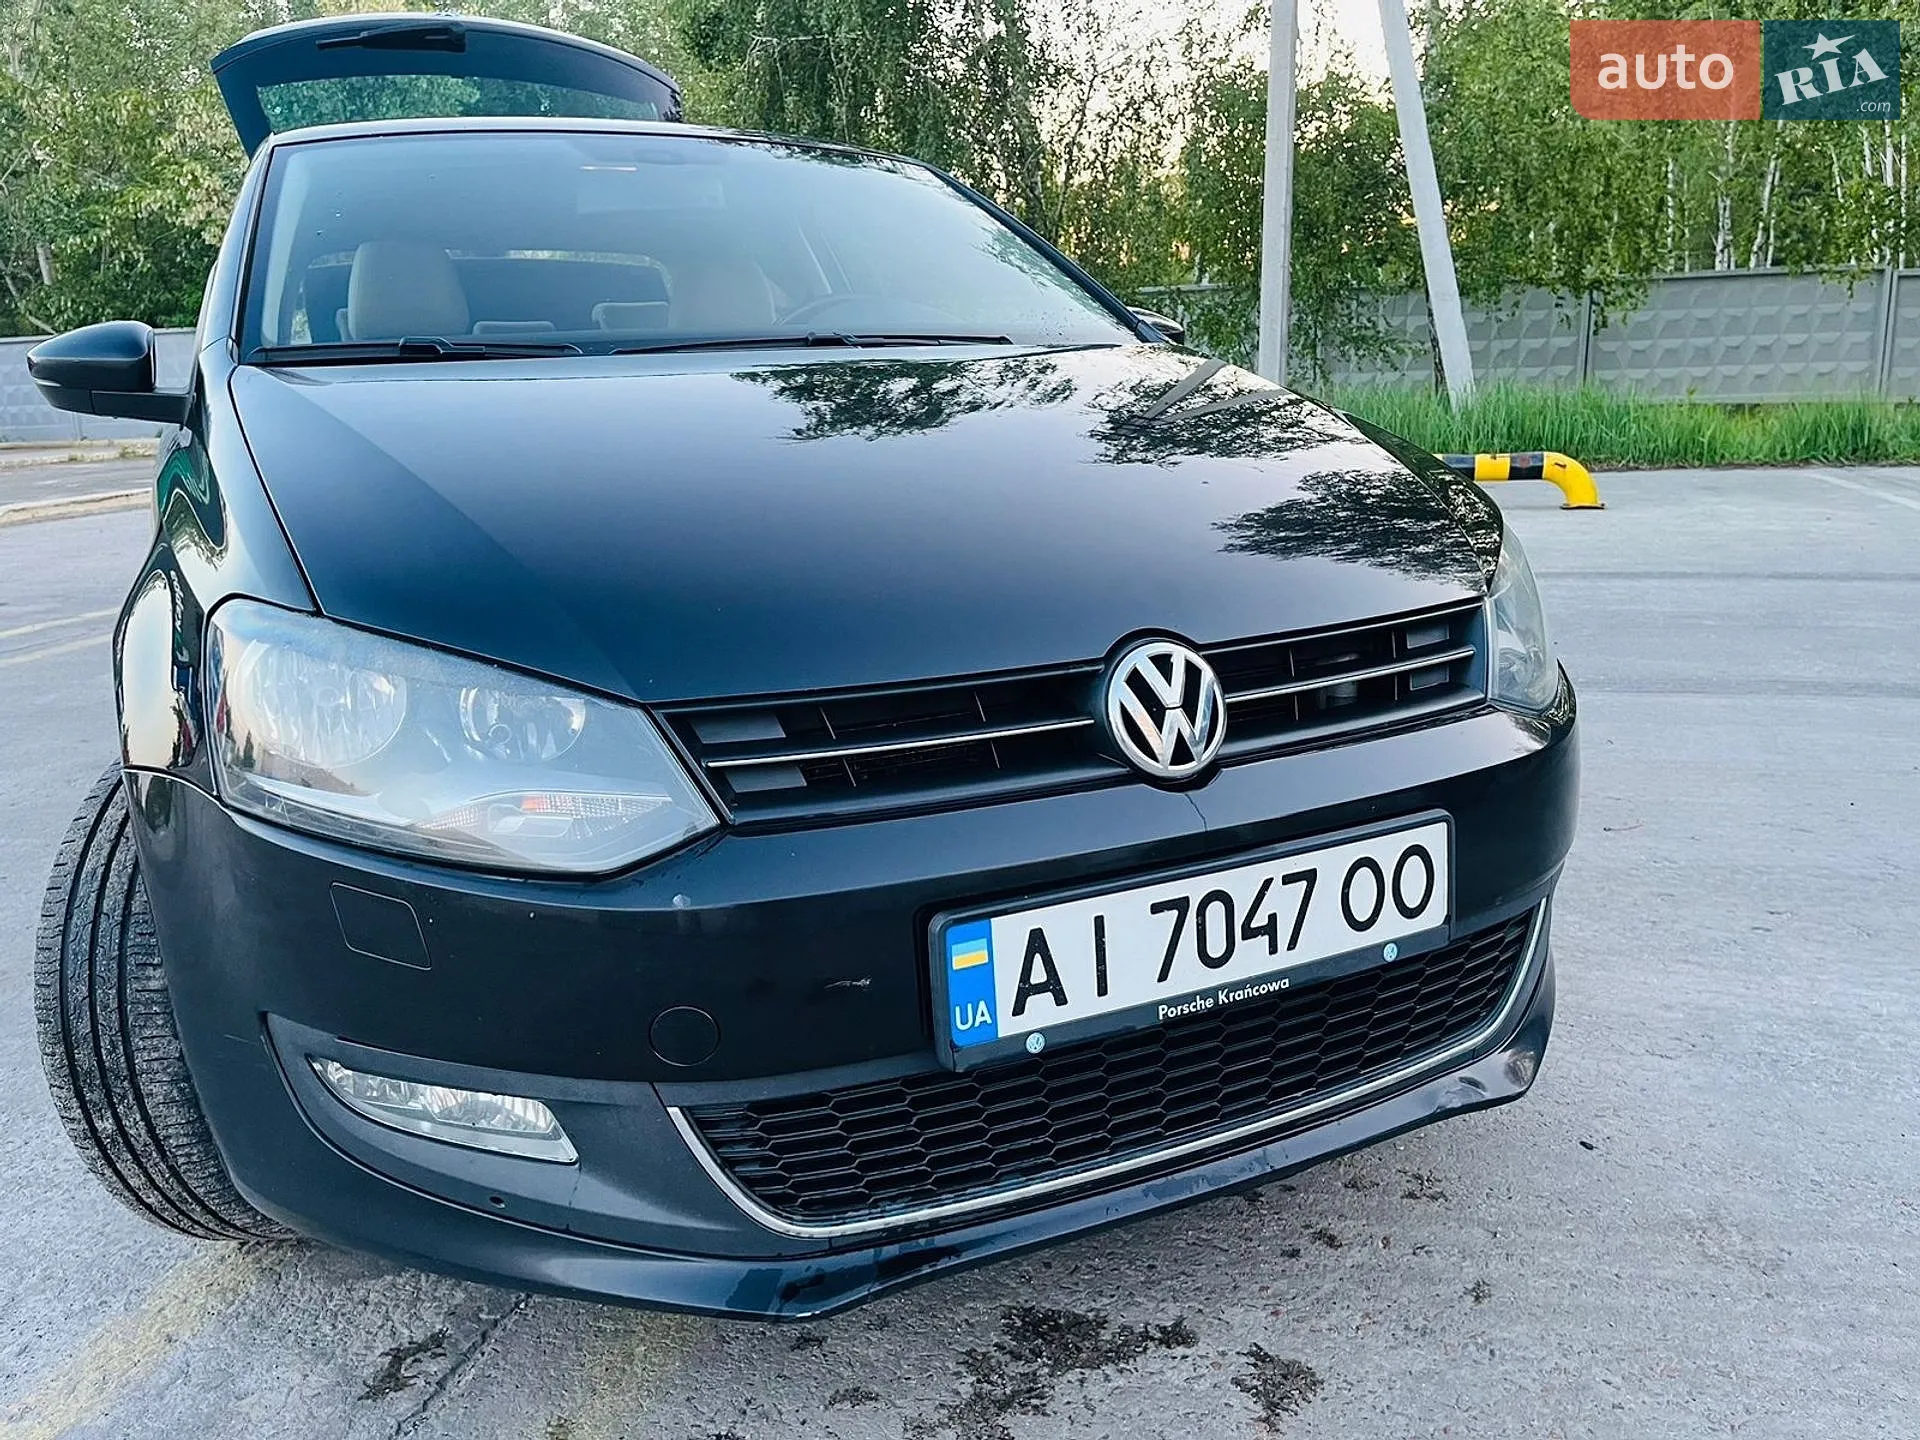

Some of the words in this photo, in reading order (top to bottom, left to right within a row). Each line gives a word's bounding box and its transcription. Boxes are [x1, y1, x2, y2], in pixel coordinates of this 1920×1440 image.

[1110, 645, 1222, 774] VW
[1150, 868, 1318, 983] 7047
[1341, 844, 1435, 933] OO
[955, 1001, 992, 1032] UA
[1158, 996, 1214, 1021] Porsche
[1218, 975, 1290, 1005] Krańcowa
